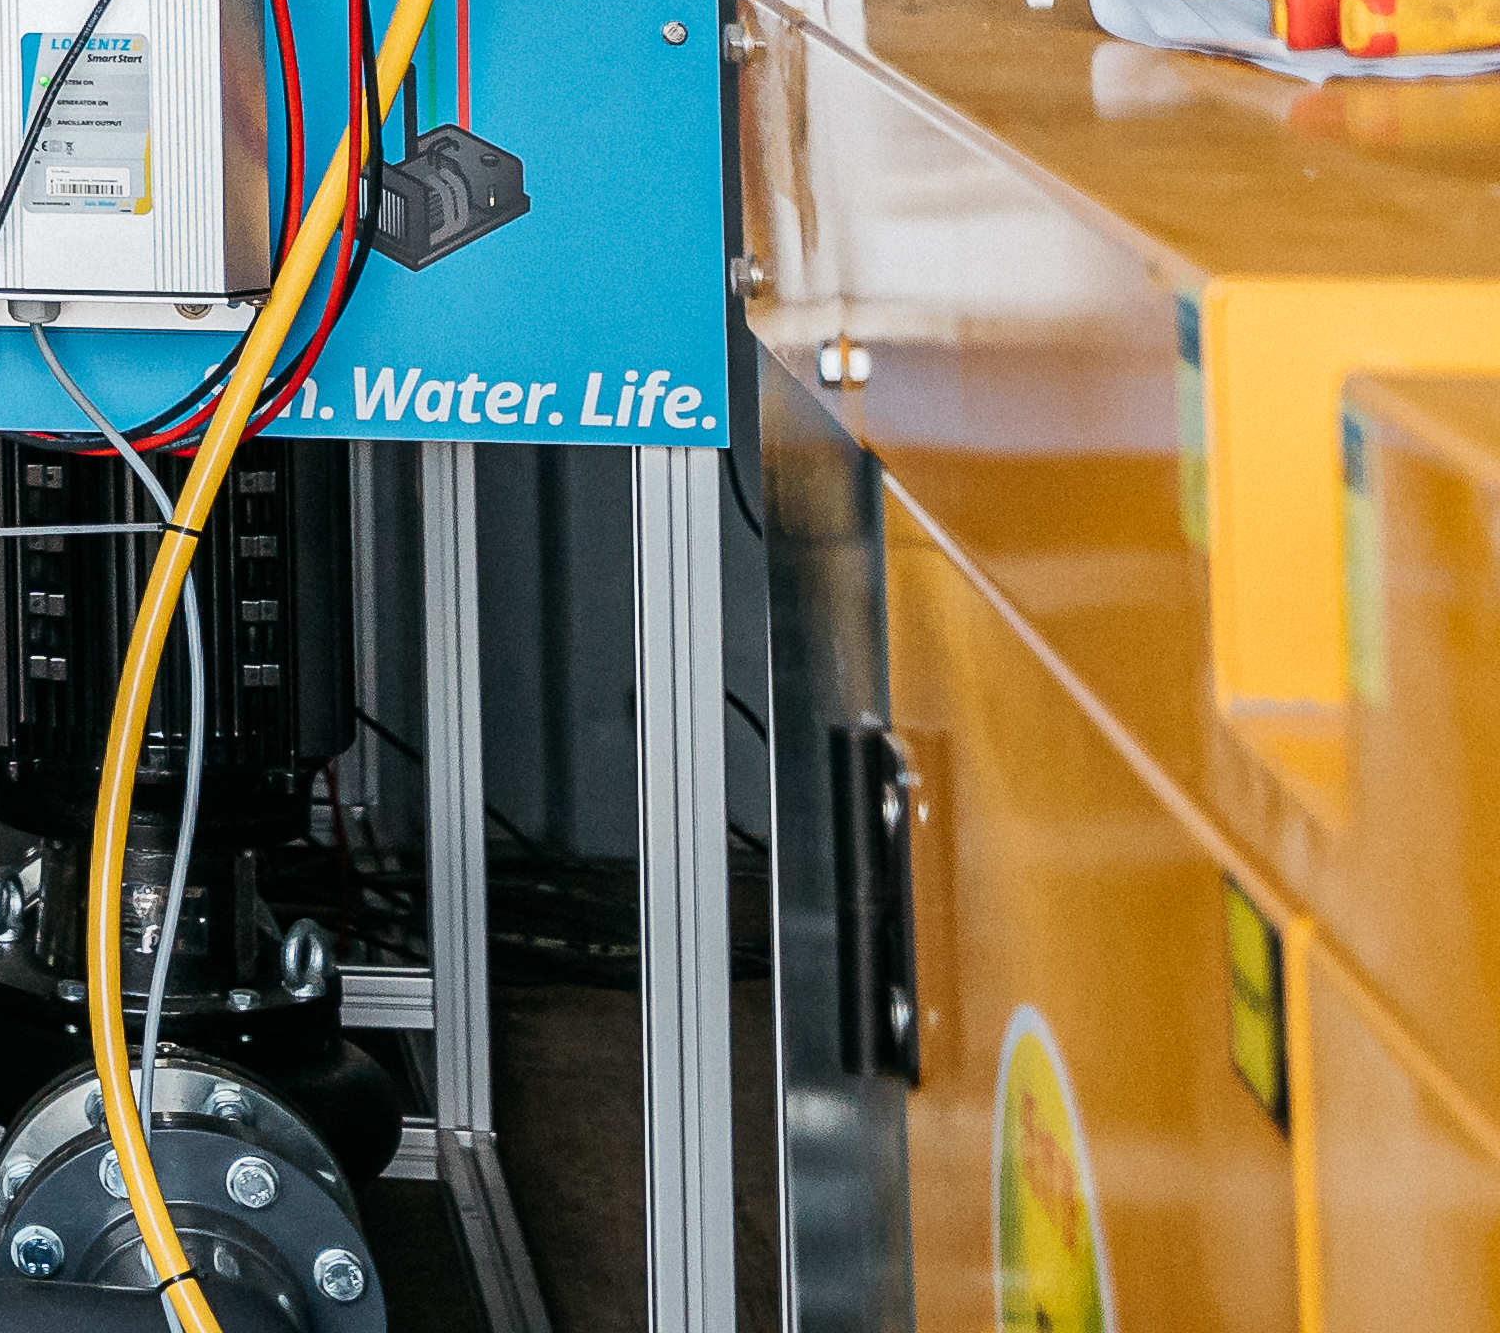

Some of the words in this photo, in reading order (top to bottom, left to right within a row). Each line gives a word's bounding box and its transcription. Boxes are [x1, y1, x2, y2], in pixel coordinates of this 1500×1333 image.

[51, 38, 132, 51] LOENTZ
[87, 53, 118, 63] Smart
[118, 54, 143, 64] Start
[352, 366, 563, 426] Water.
[579, 369, 717, 431] Life.
